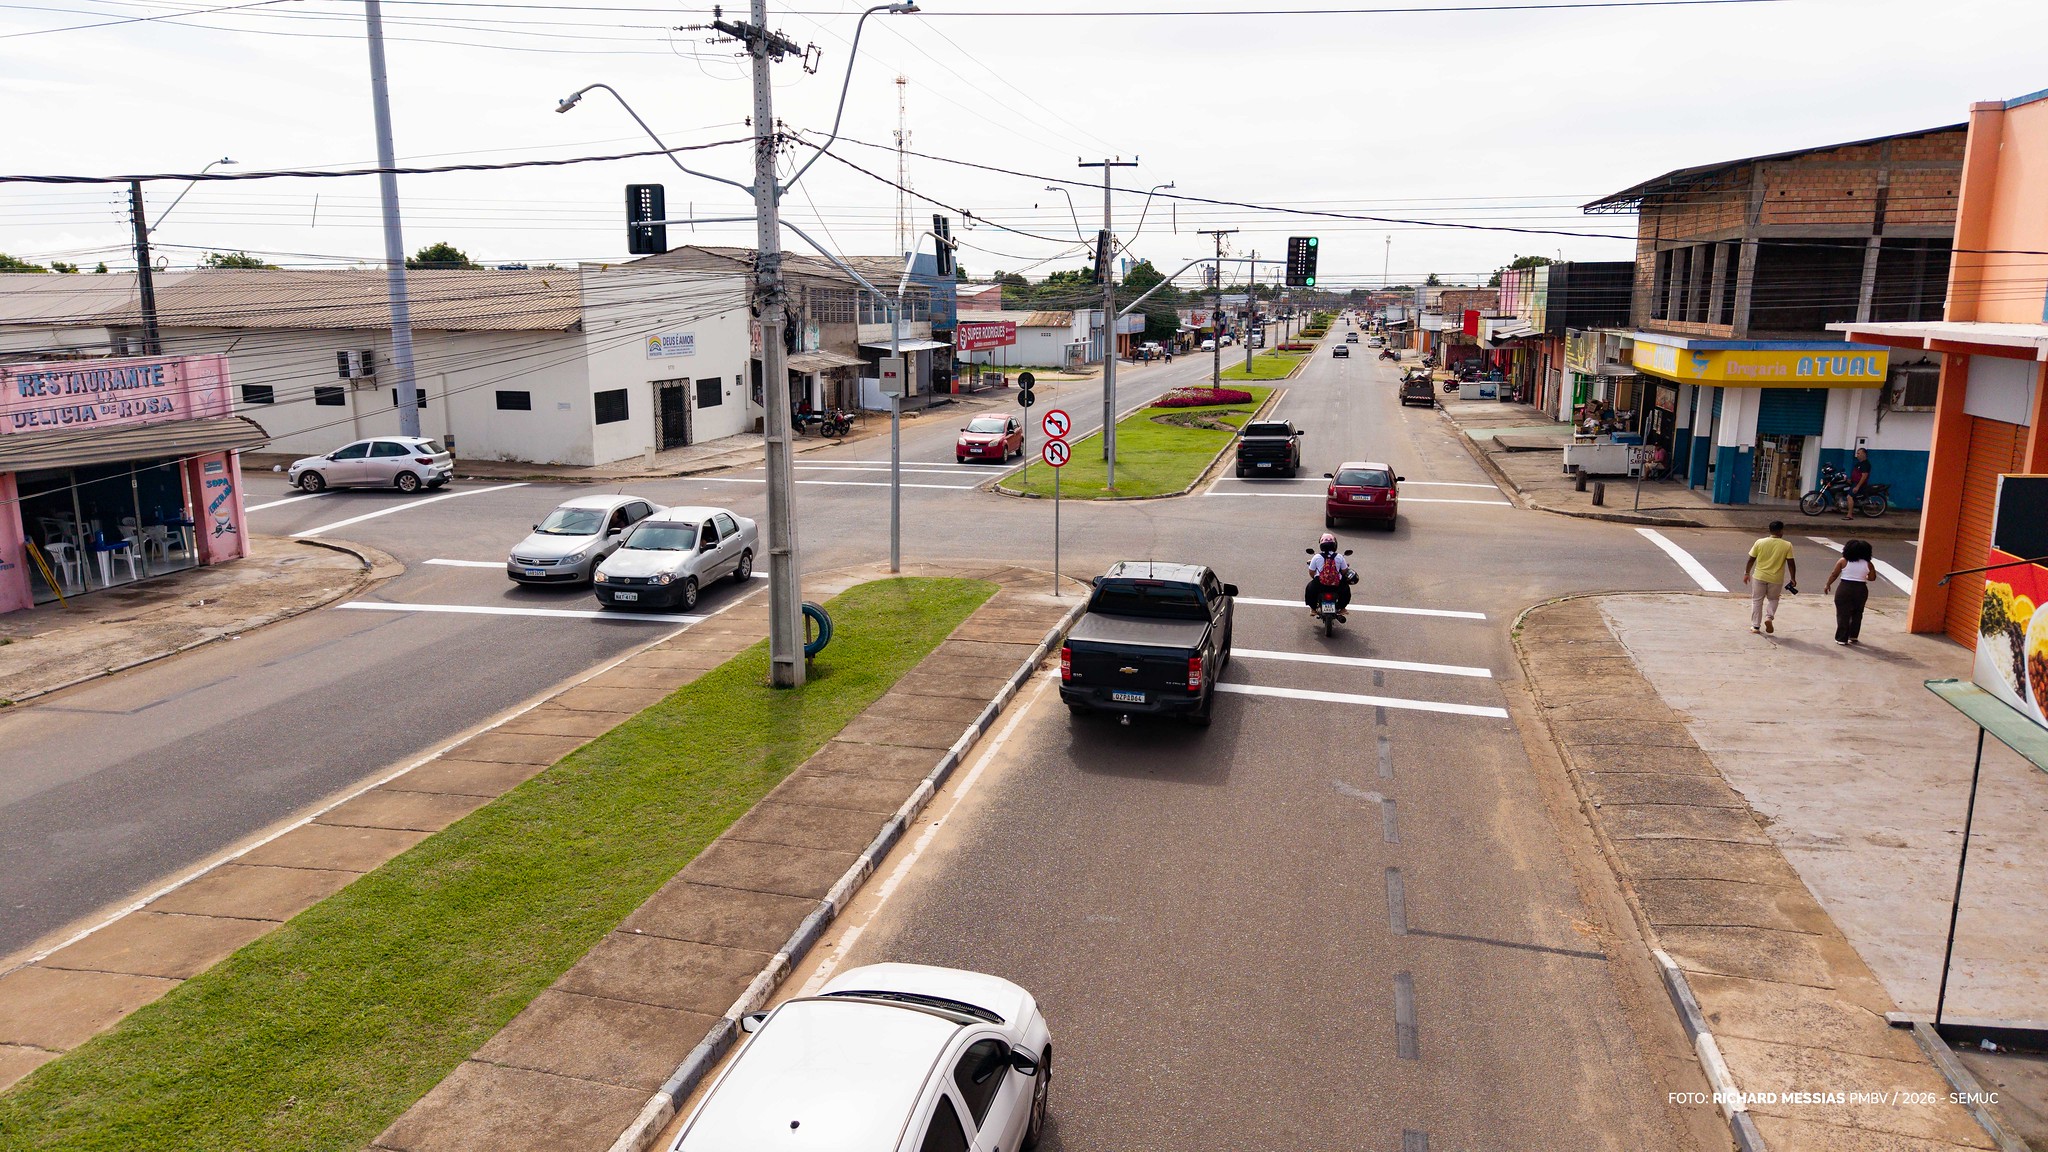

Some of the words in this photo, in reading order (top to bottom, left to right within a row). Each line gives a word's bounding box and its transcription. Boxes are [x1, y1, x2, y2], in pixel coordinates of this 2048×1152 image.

[662, 336, 675, 346] DEUS
[676, 333, 679, 345] É
[679, 335, 694, 344] AMOR
[967, 327, 982, 340] SUPER
[982, 325, 1005, 339] RODRIGUES
[1726, 360, 1788, 377] Drogaria
[1796, 356, 1881, 377] ATUAL
[17, 364, 165, 397] RESTAURANTE
[12, 404, 97, 429] DELICIA
[100, 404, 117, 415] DE
[117, 396, 174, 418] ROSA
[206, 477, 229, 489] SOPA
